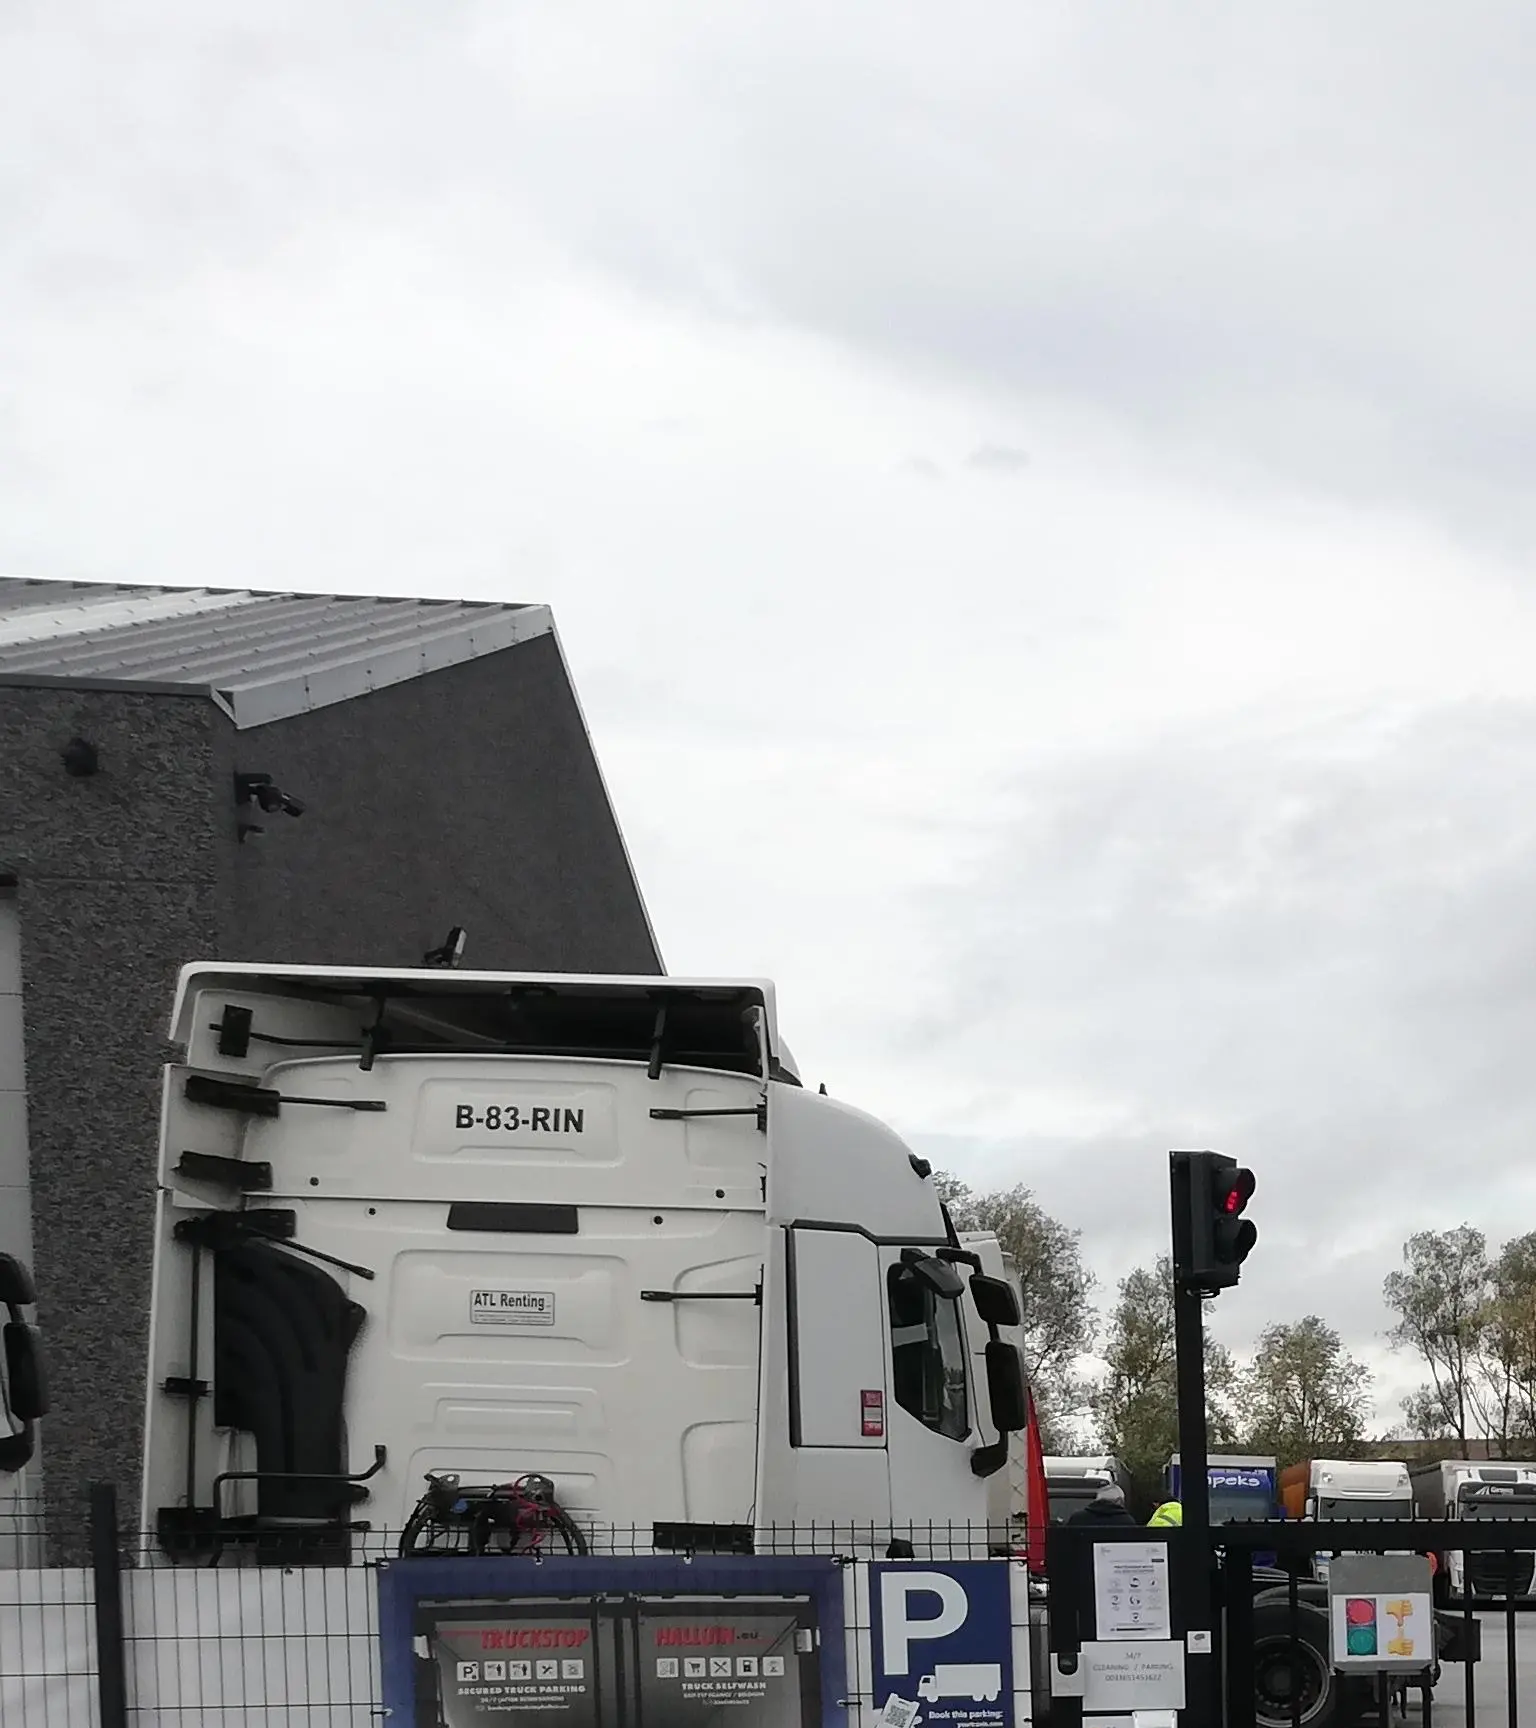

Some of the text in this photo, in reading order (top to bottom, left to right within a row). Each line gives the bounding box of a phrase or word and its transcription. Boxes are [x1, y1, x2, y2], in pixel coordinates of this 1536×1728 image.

[455, 1104, 584, 1133] B-83-RIN
[474, 1293, 545, 1311] ATL Renting
[881, 1571, 968, 1675] P
[481, 1629, 590, 1649] TRUCKSTOP
[457, 1685, 586, 1695] SECURED TRUCK PARKING
[682, 1682, 714, 1690] TRUCK
[928, 1710, 951, 1719] Book
[952, 1710, 968, 1719] this
